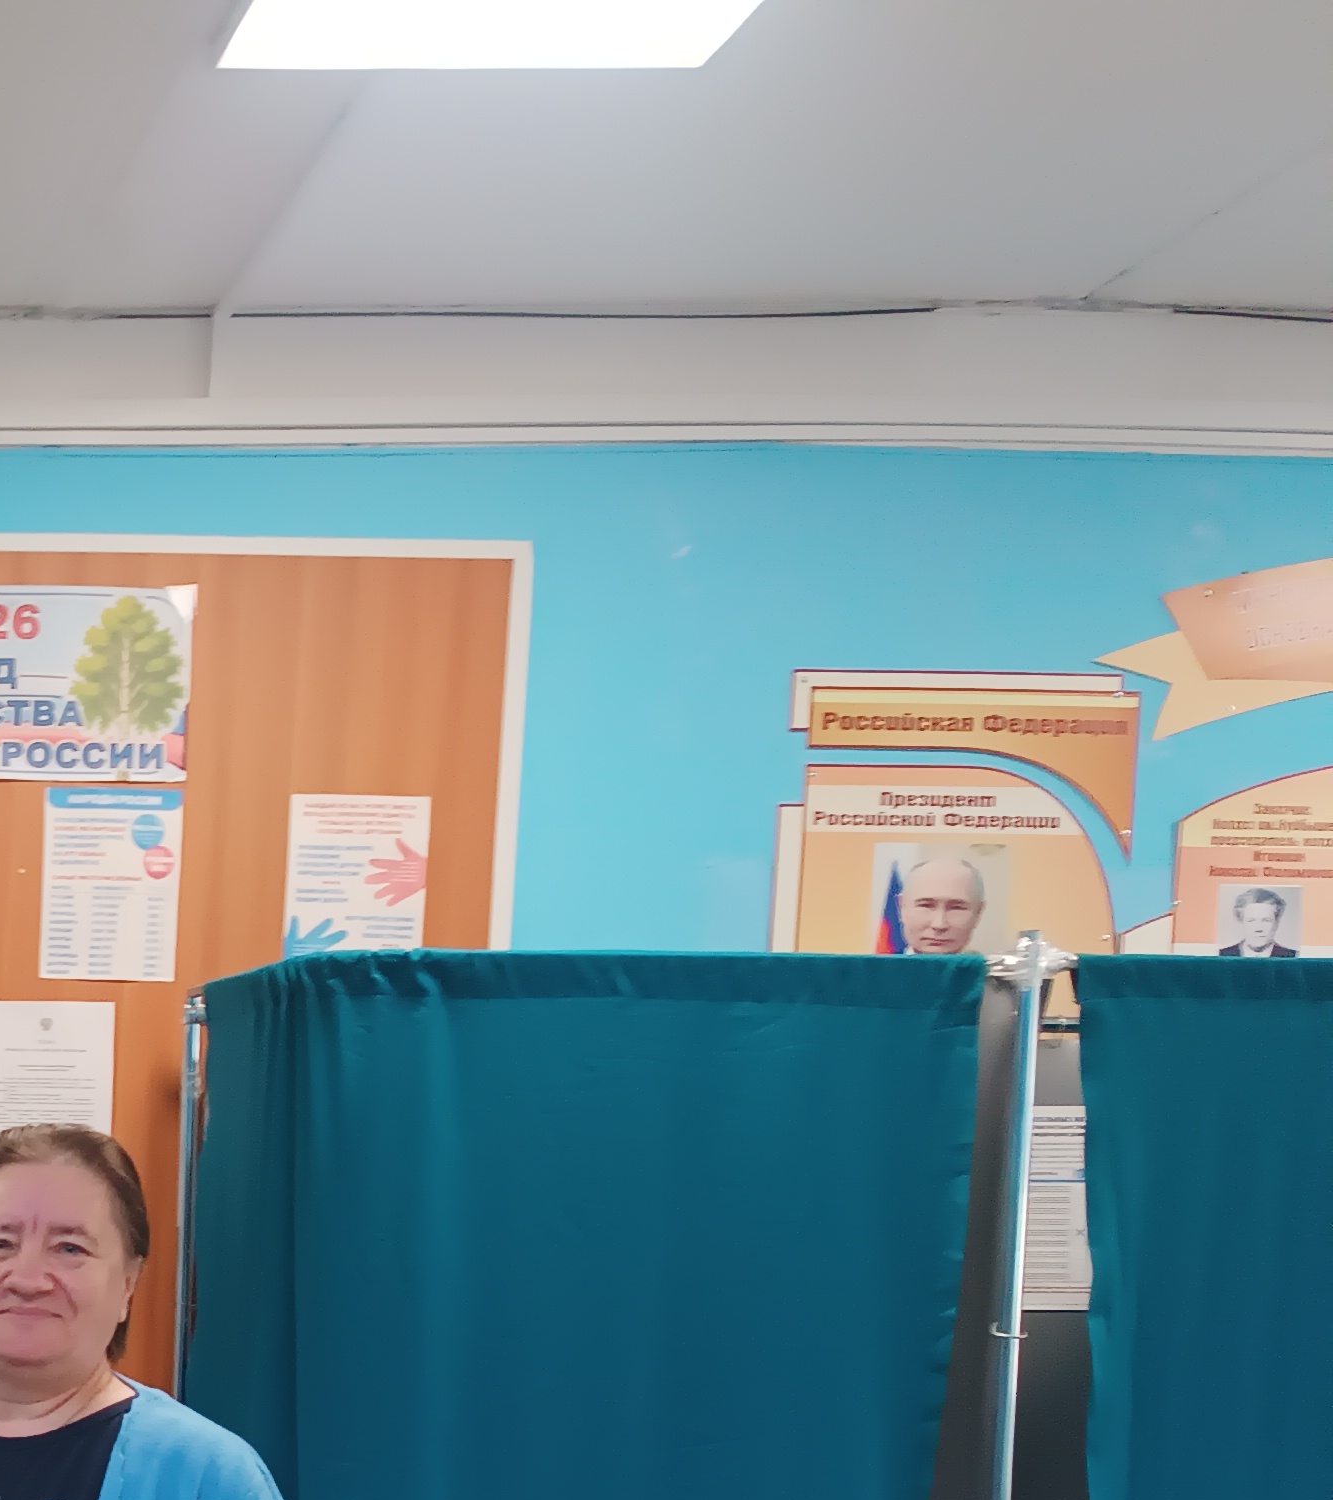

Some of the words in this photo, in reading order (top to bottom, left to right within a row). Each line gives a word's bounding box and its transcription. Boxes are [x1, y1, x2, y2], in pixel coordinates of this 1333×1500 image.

[821, 712, 974, 733] Российская
[983, 713, 1129, 737] Федерация
[0, 735, 165, 770] РОССИИ
[879, 791, 997, 809] Президент
[812, 810, 937, 828] Российской
[944, 811, 1061, 831] Федерации
